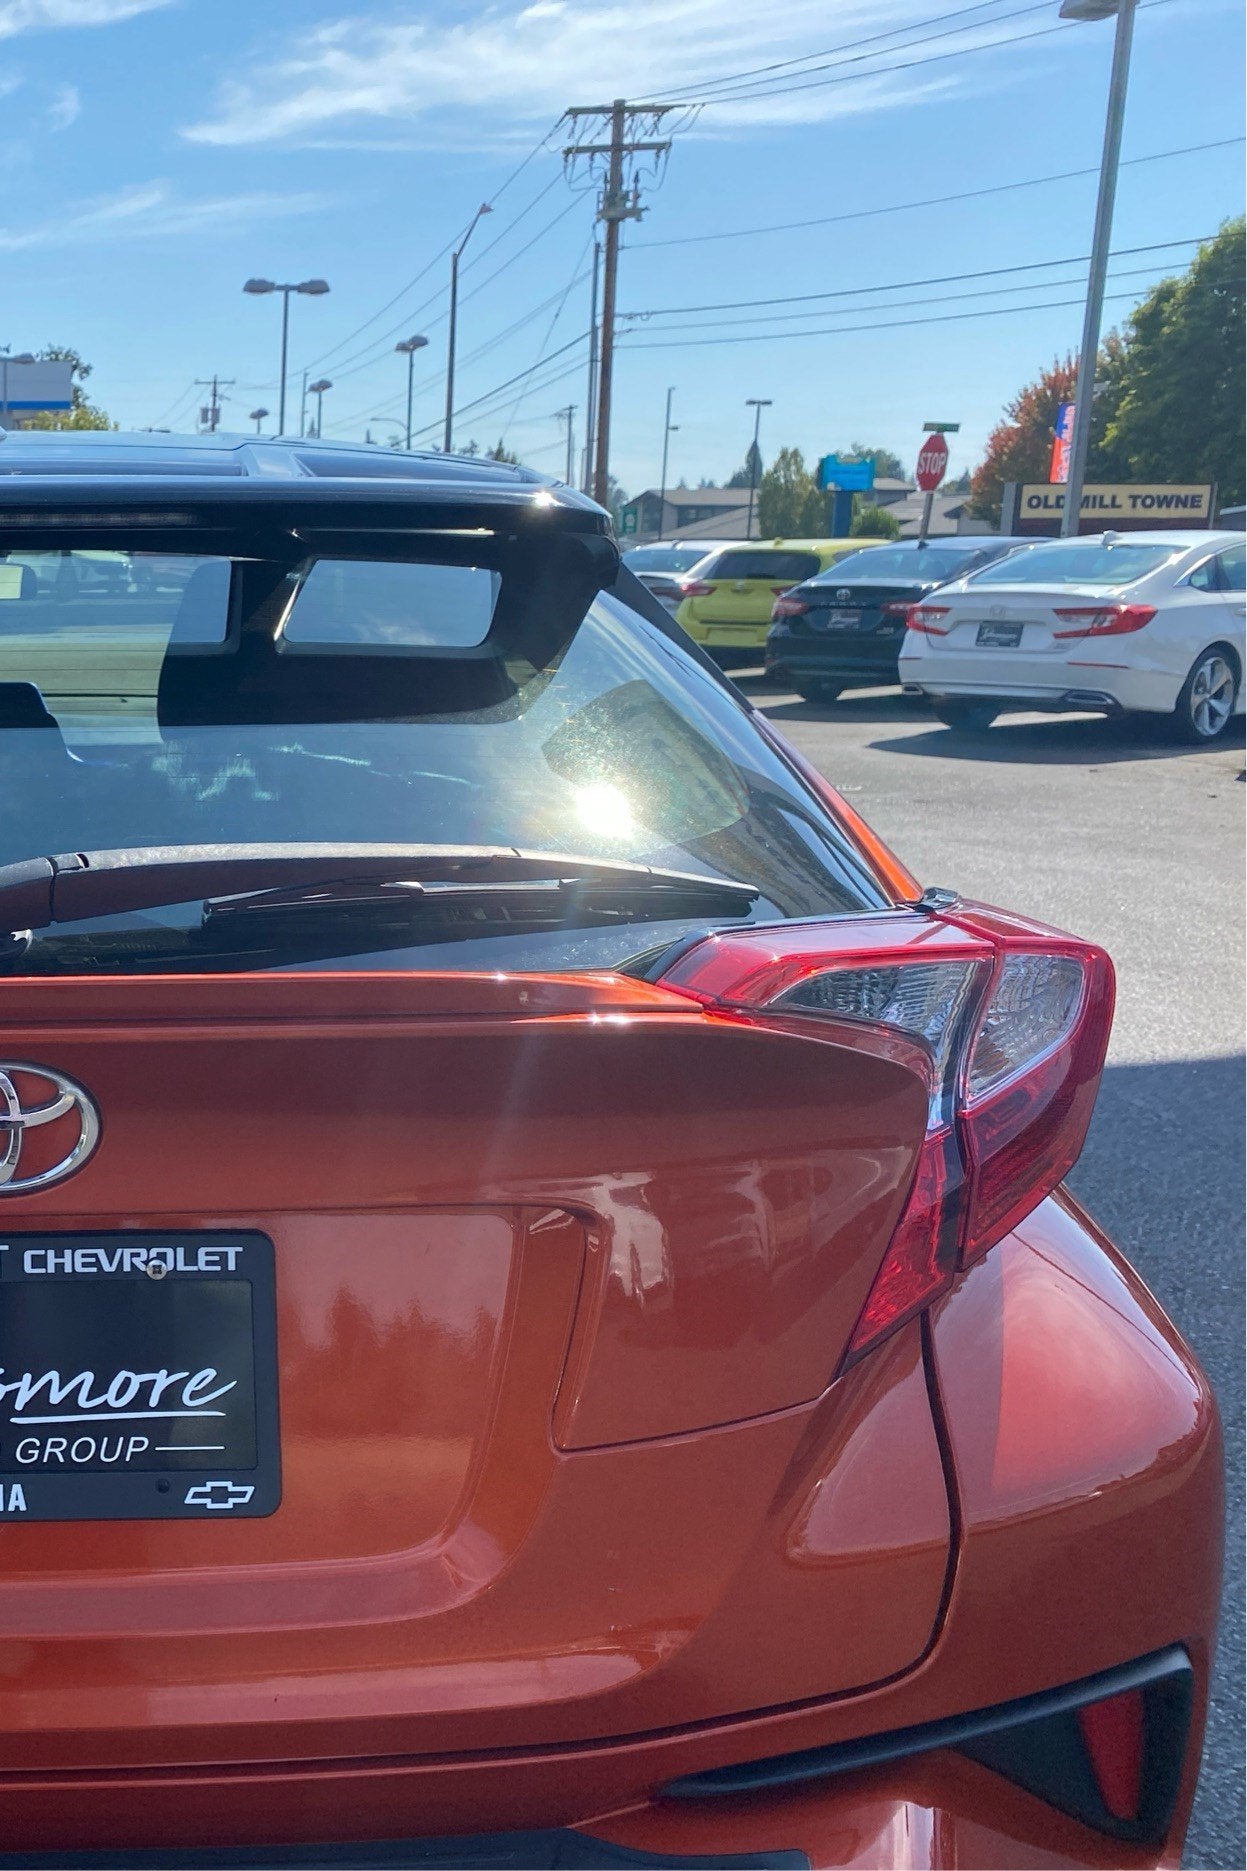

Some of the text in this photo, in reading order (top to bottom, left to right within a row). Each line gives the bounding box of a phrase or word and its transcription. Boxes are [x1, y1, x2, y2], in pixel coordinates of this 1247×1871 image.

[918, 452, 947, 475] STOP
[1128, 494, 1203, 509] TOWNE
[23, 1245, 243, 1275] CHEVROLET
[15, 1436, 150, 1464] GROUP
